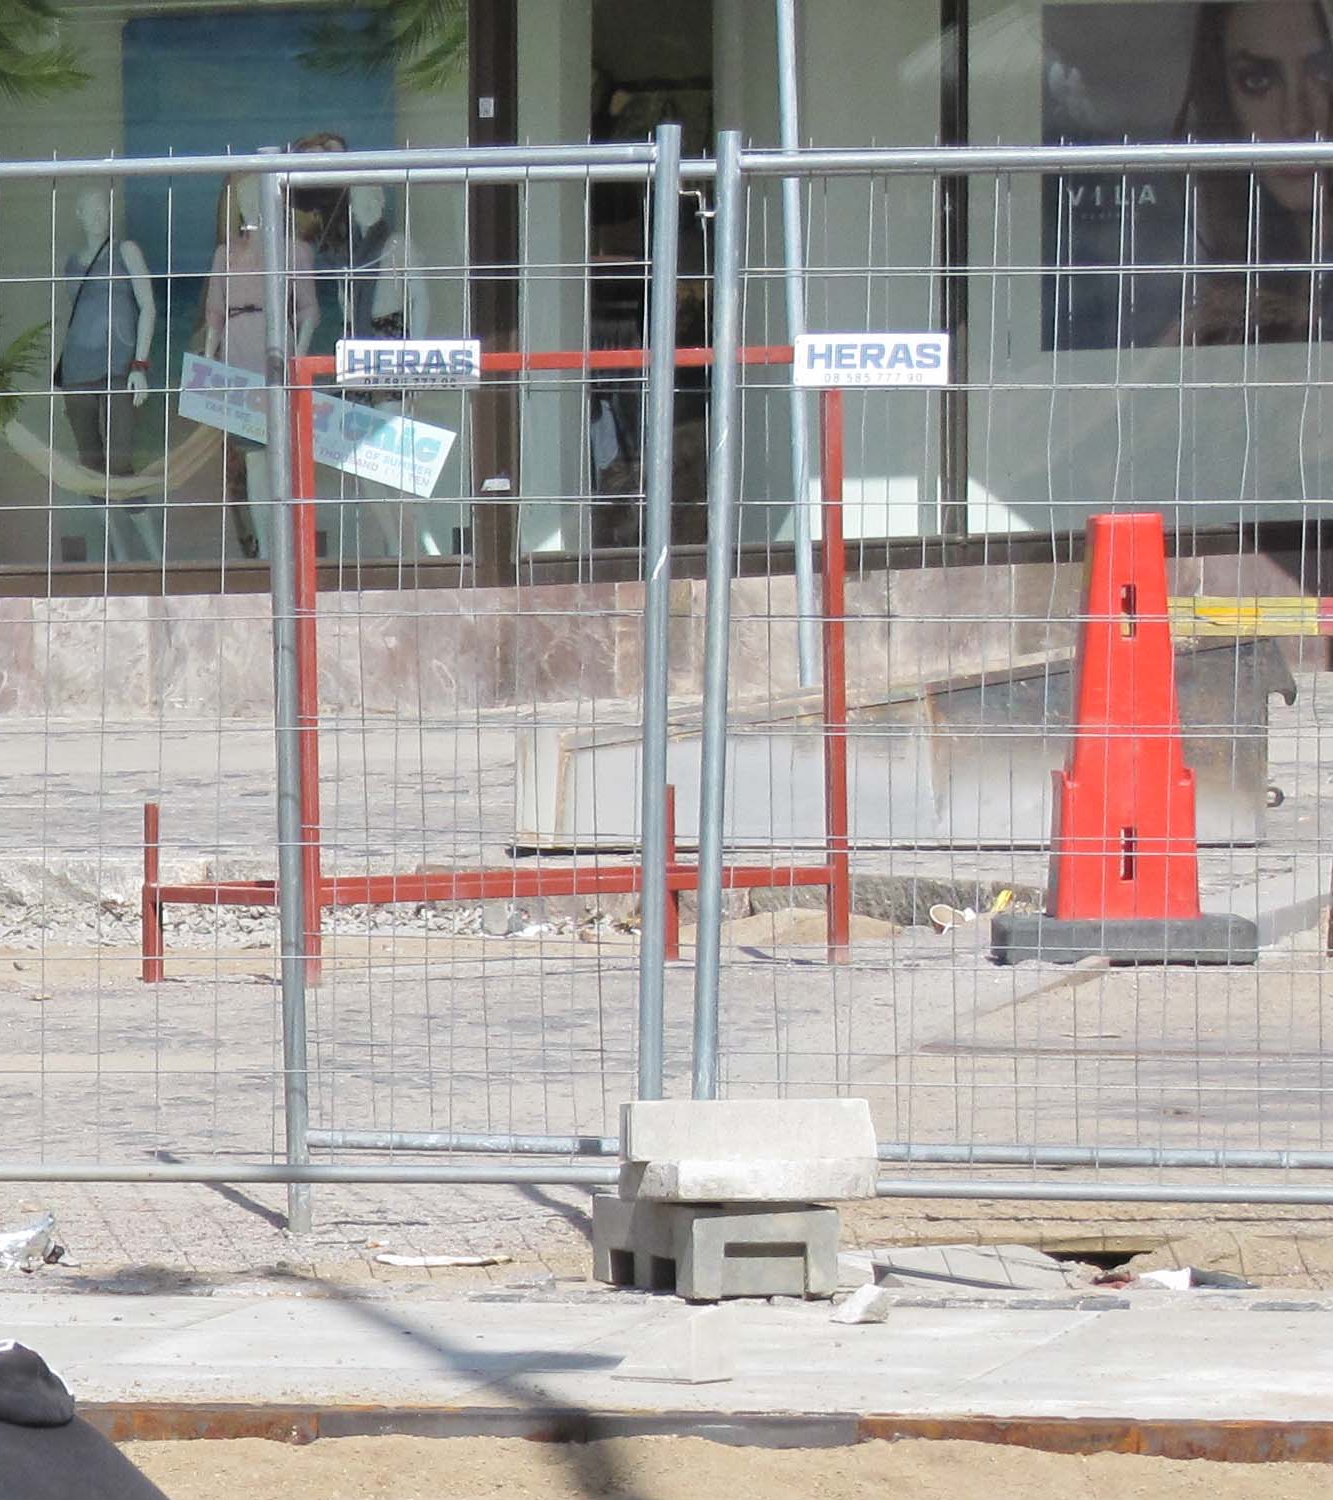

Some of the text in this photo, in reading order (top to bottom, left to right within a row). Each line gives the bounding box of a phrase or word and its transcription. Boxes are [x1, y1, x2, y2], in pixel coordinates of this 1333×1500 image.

[1066, 184, 1157, 206] VILA
[347, 349, 473, 375] HERAS
[806, 343, 942, 369] HERAS
[824, 373, 923, 383] 08 585 777 90
